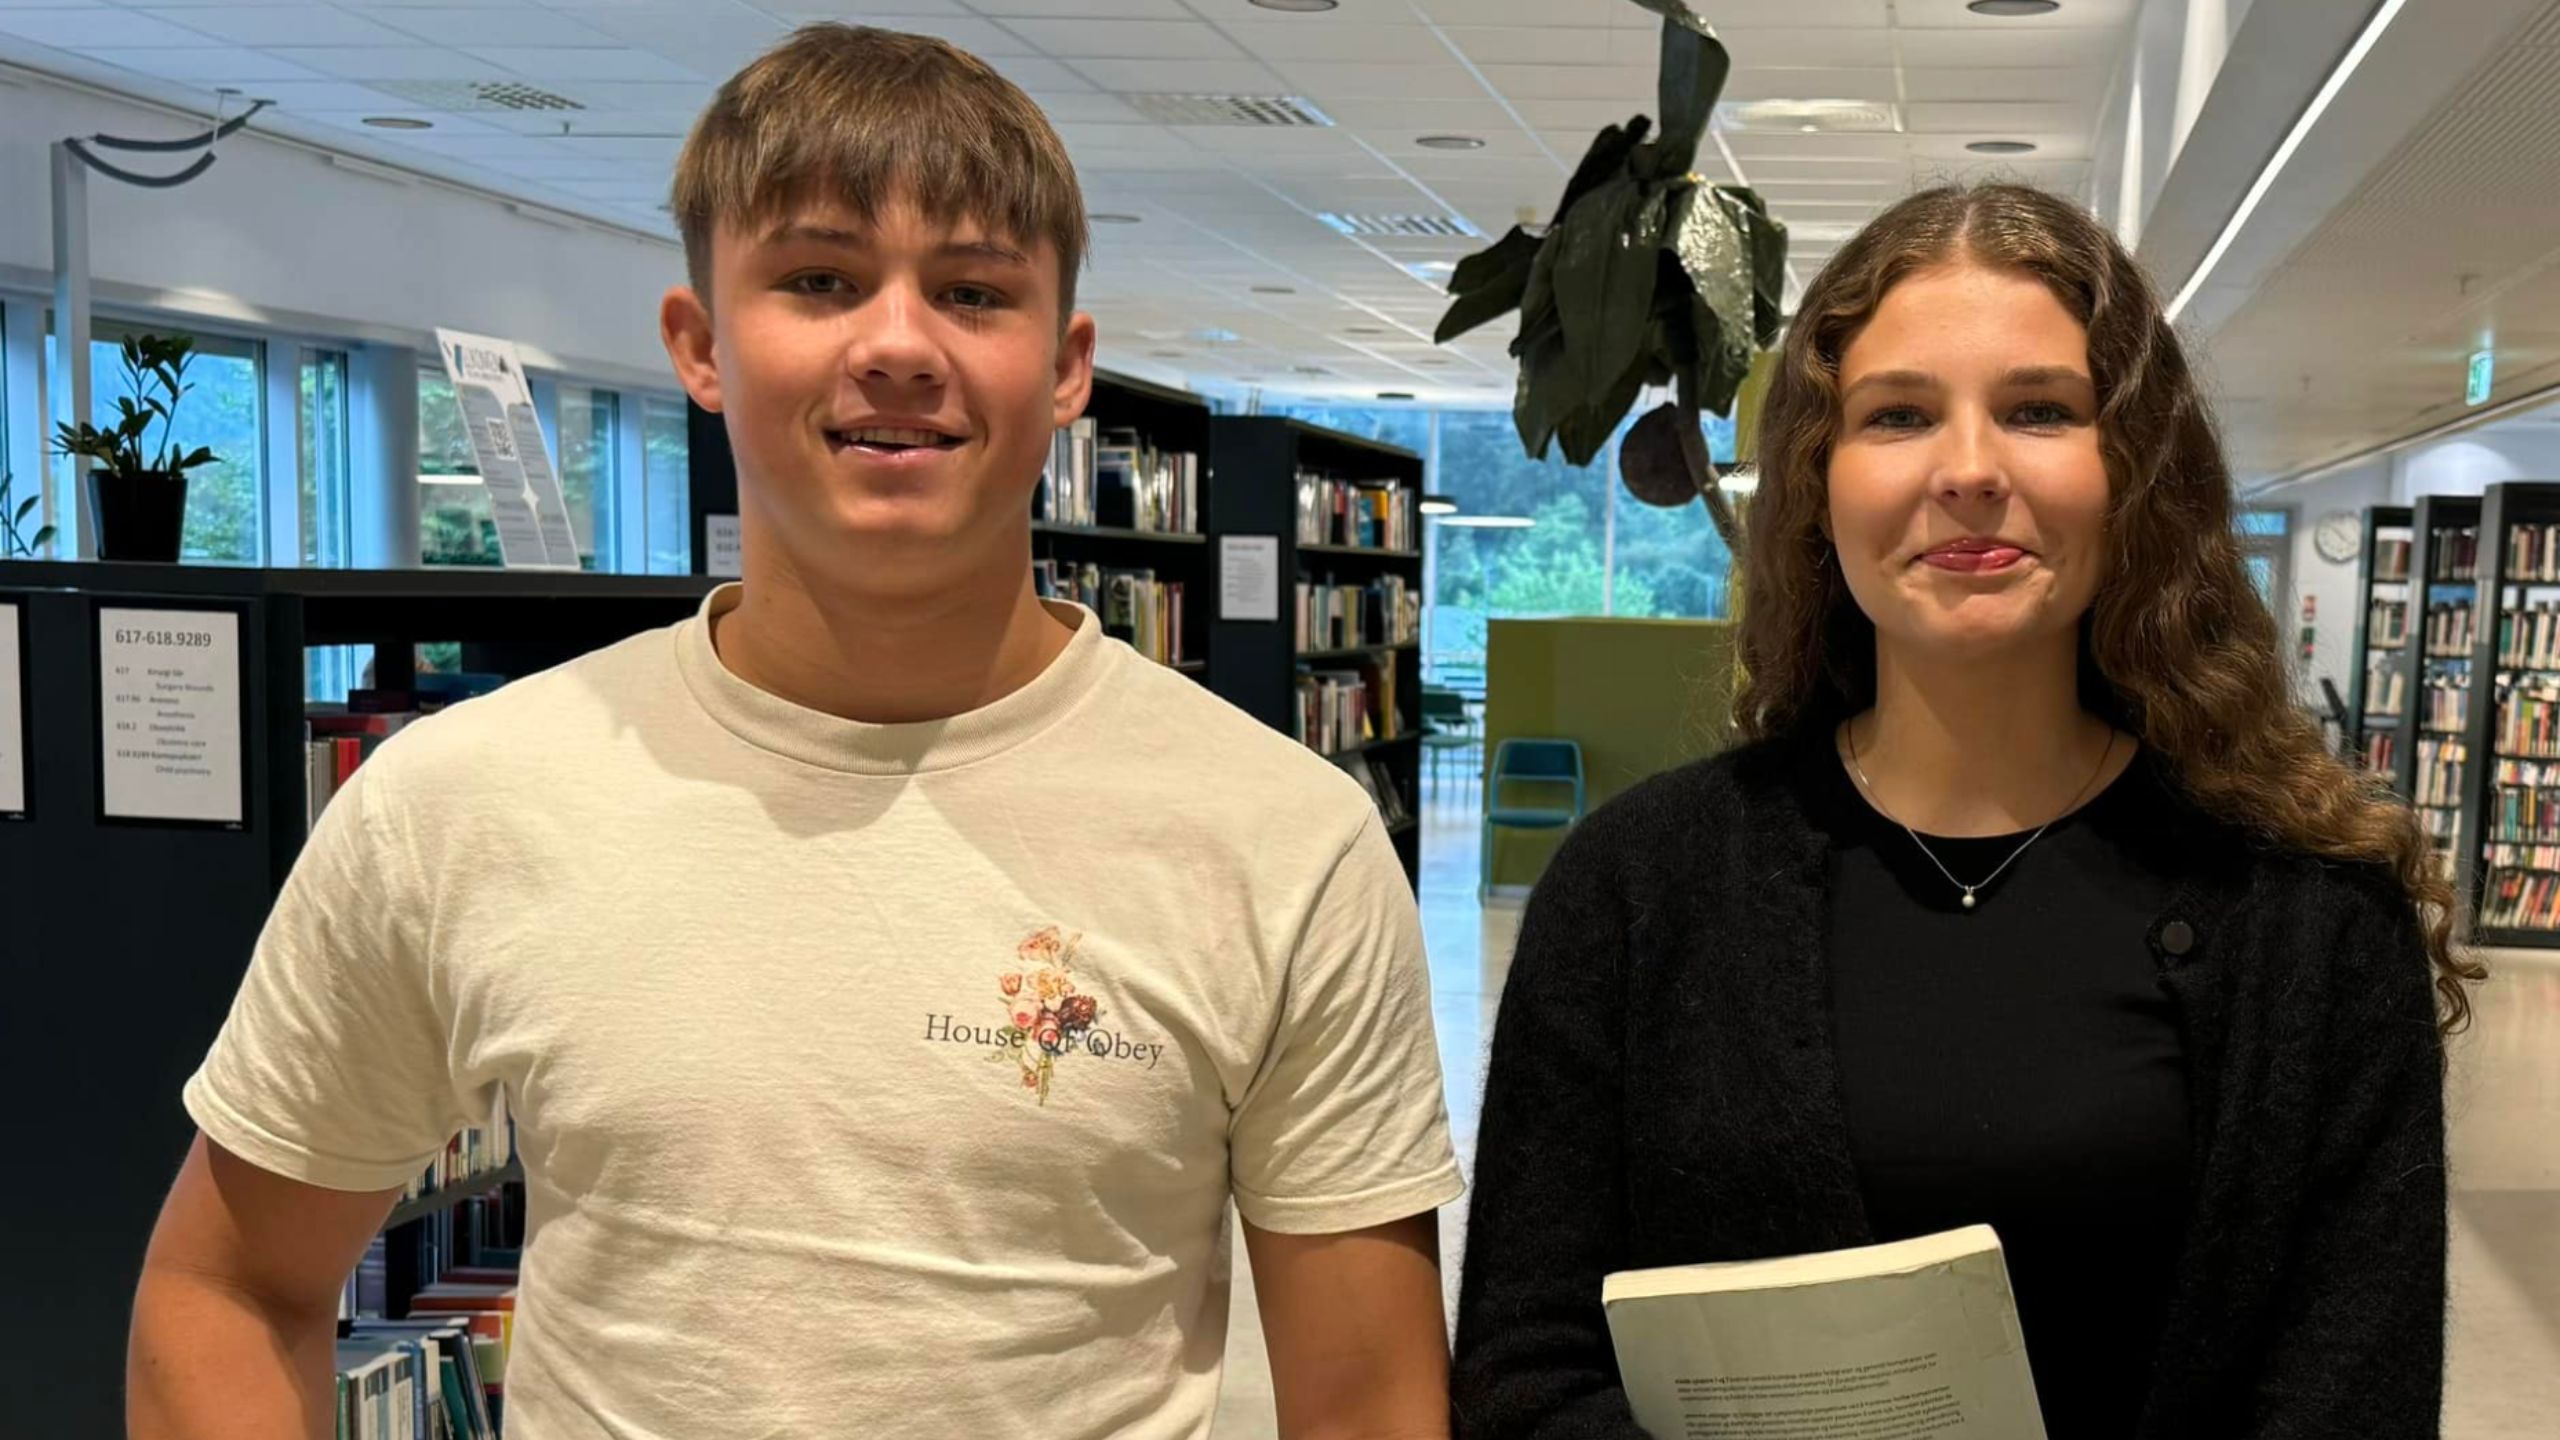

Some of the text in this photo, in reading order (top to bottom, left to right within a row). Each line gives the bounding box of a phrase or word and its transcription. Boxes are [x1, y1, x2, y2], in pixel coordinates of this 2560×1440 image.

[115, 630, 211, 647] 617-618.9289
[924, 1013, 1025, 1048] House
[1086, 1028, 1164, 1070] Obey
